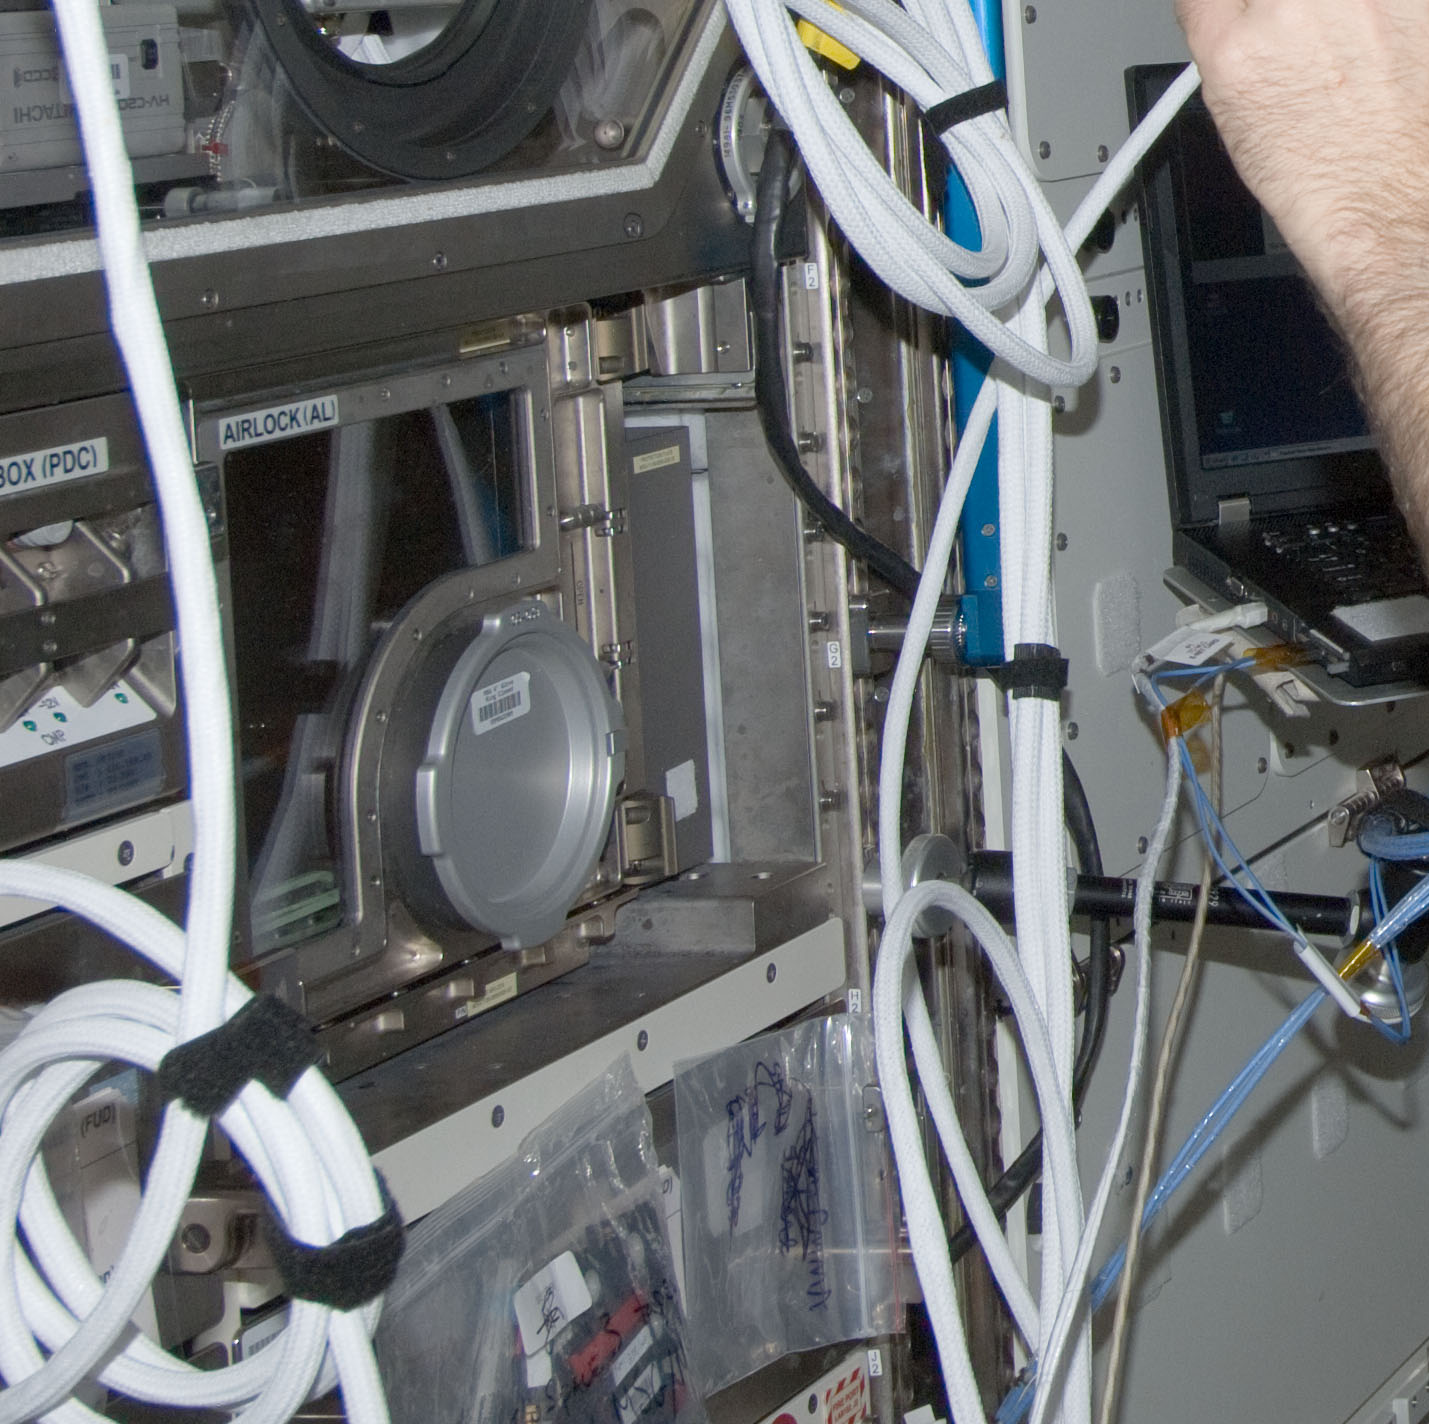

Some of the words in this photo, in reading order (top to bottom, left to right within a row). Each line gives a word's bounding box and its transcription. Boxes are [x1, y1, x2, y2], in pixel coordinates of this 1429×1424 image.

[13, 103, 74, 124] ITACHI
[42, 444, 98, 478] (PDC)
[81, 1102, 117, 1138] (FUD)
